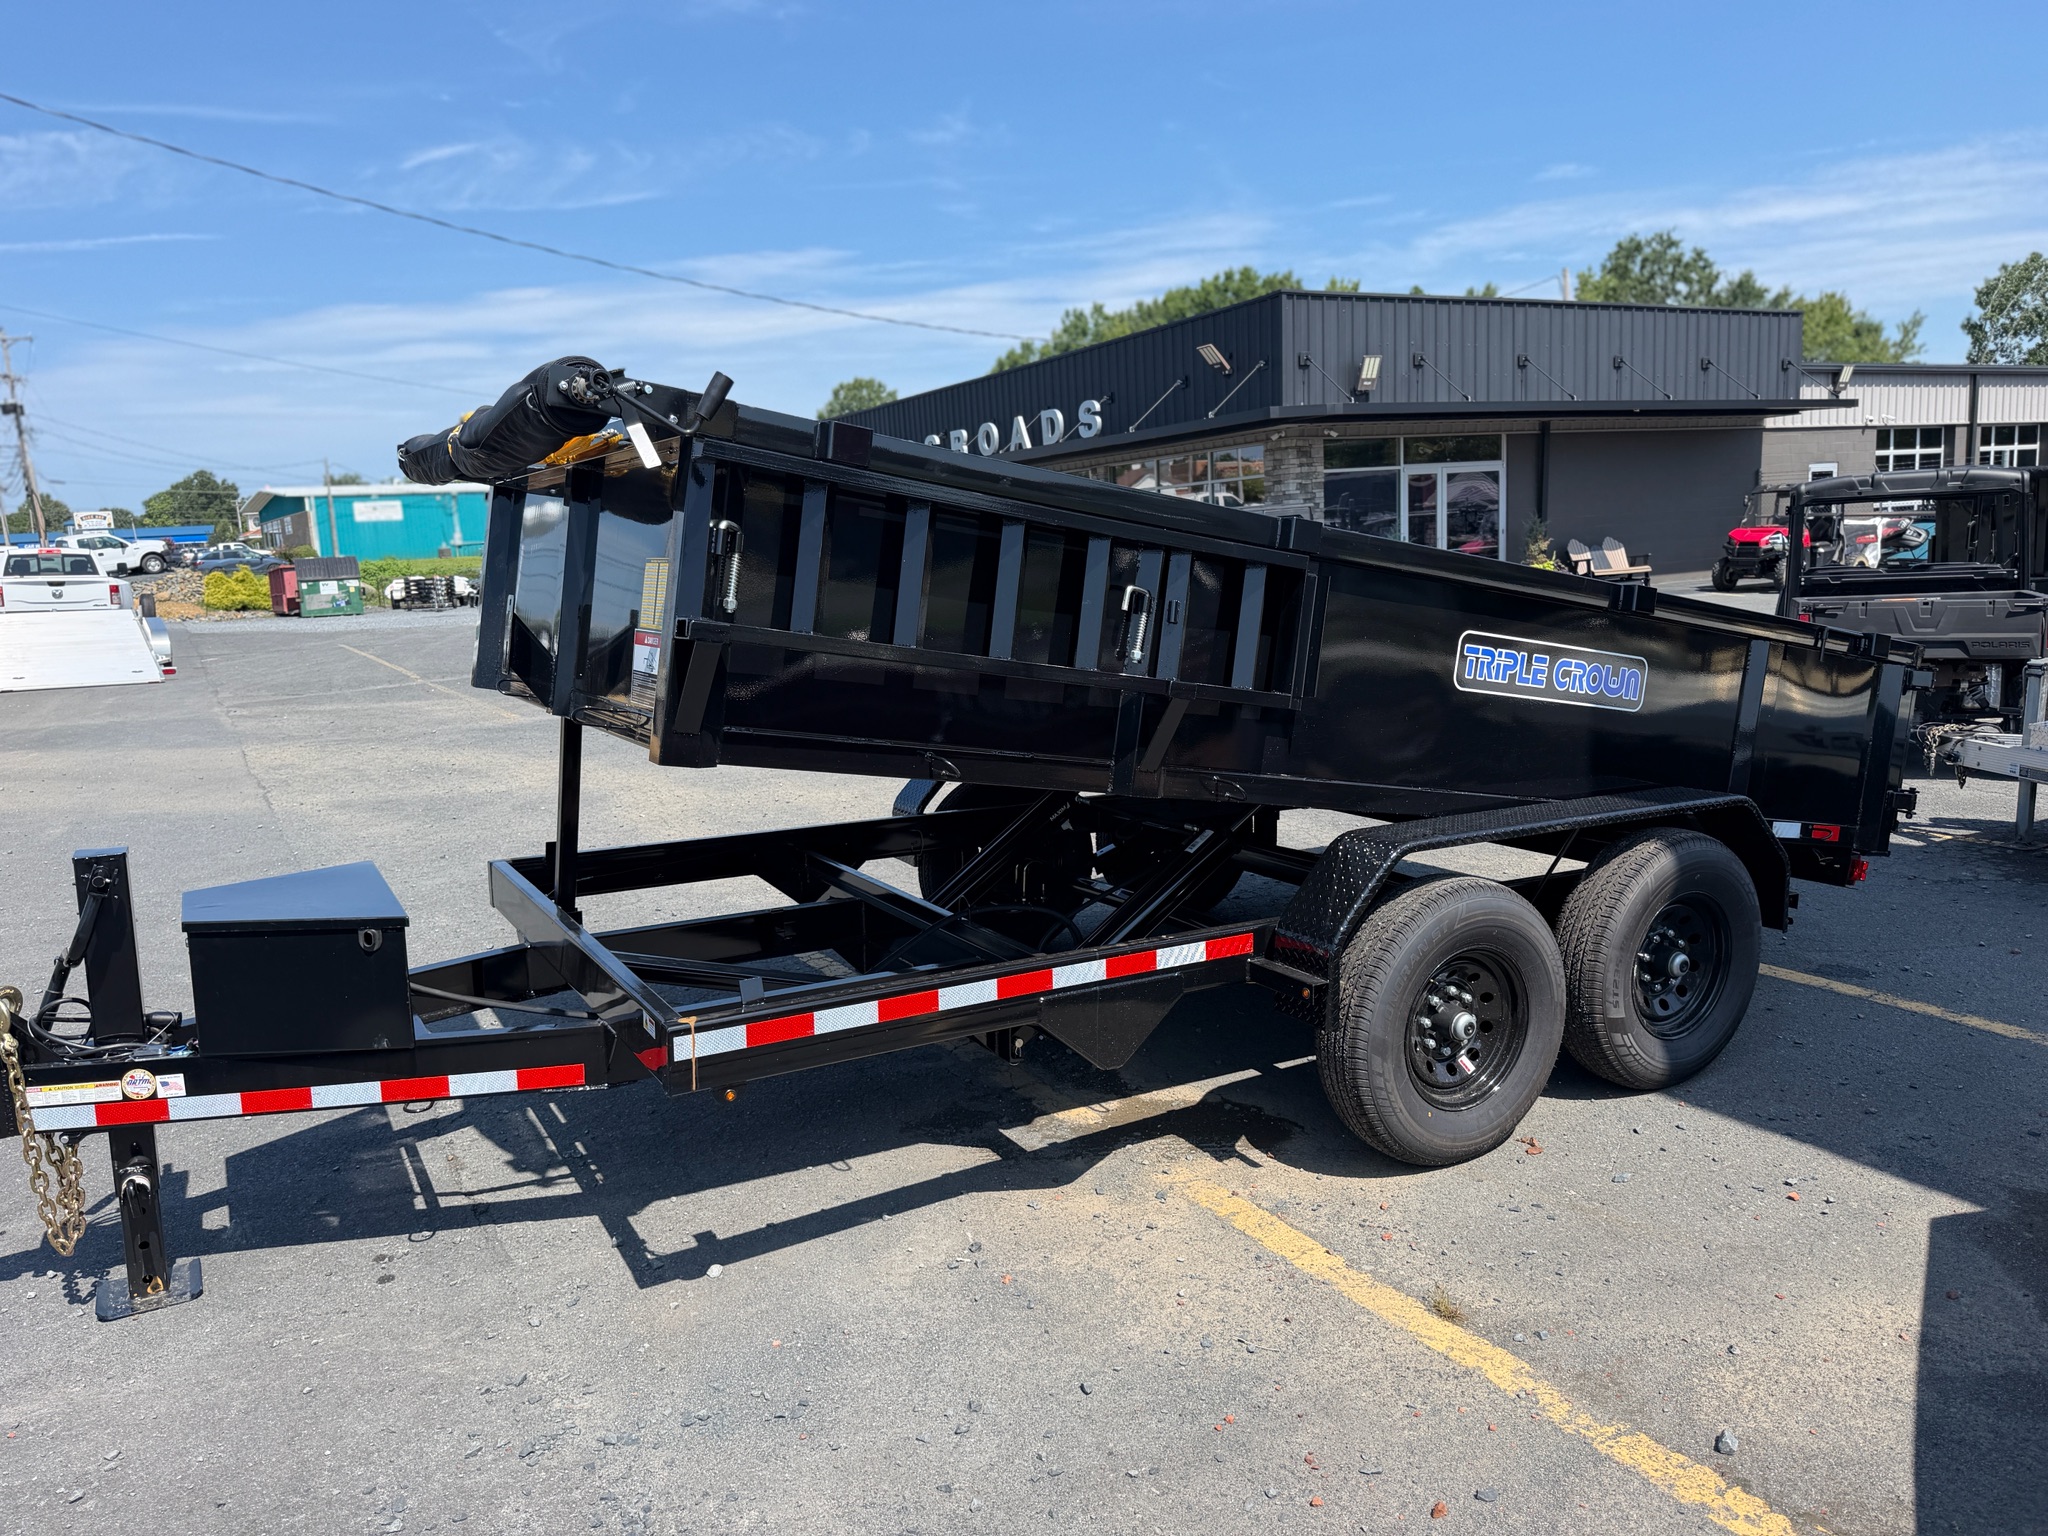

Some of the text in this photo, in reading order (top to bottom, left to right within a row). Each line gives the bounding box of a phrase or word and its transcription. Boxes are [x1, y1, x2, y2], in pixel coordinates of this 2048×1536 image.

[1971, 641, 2030, 649] POLARIS
[1464, 644, 1641, 701] TRIPLE CROWN
